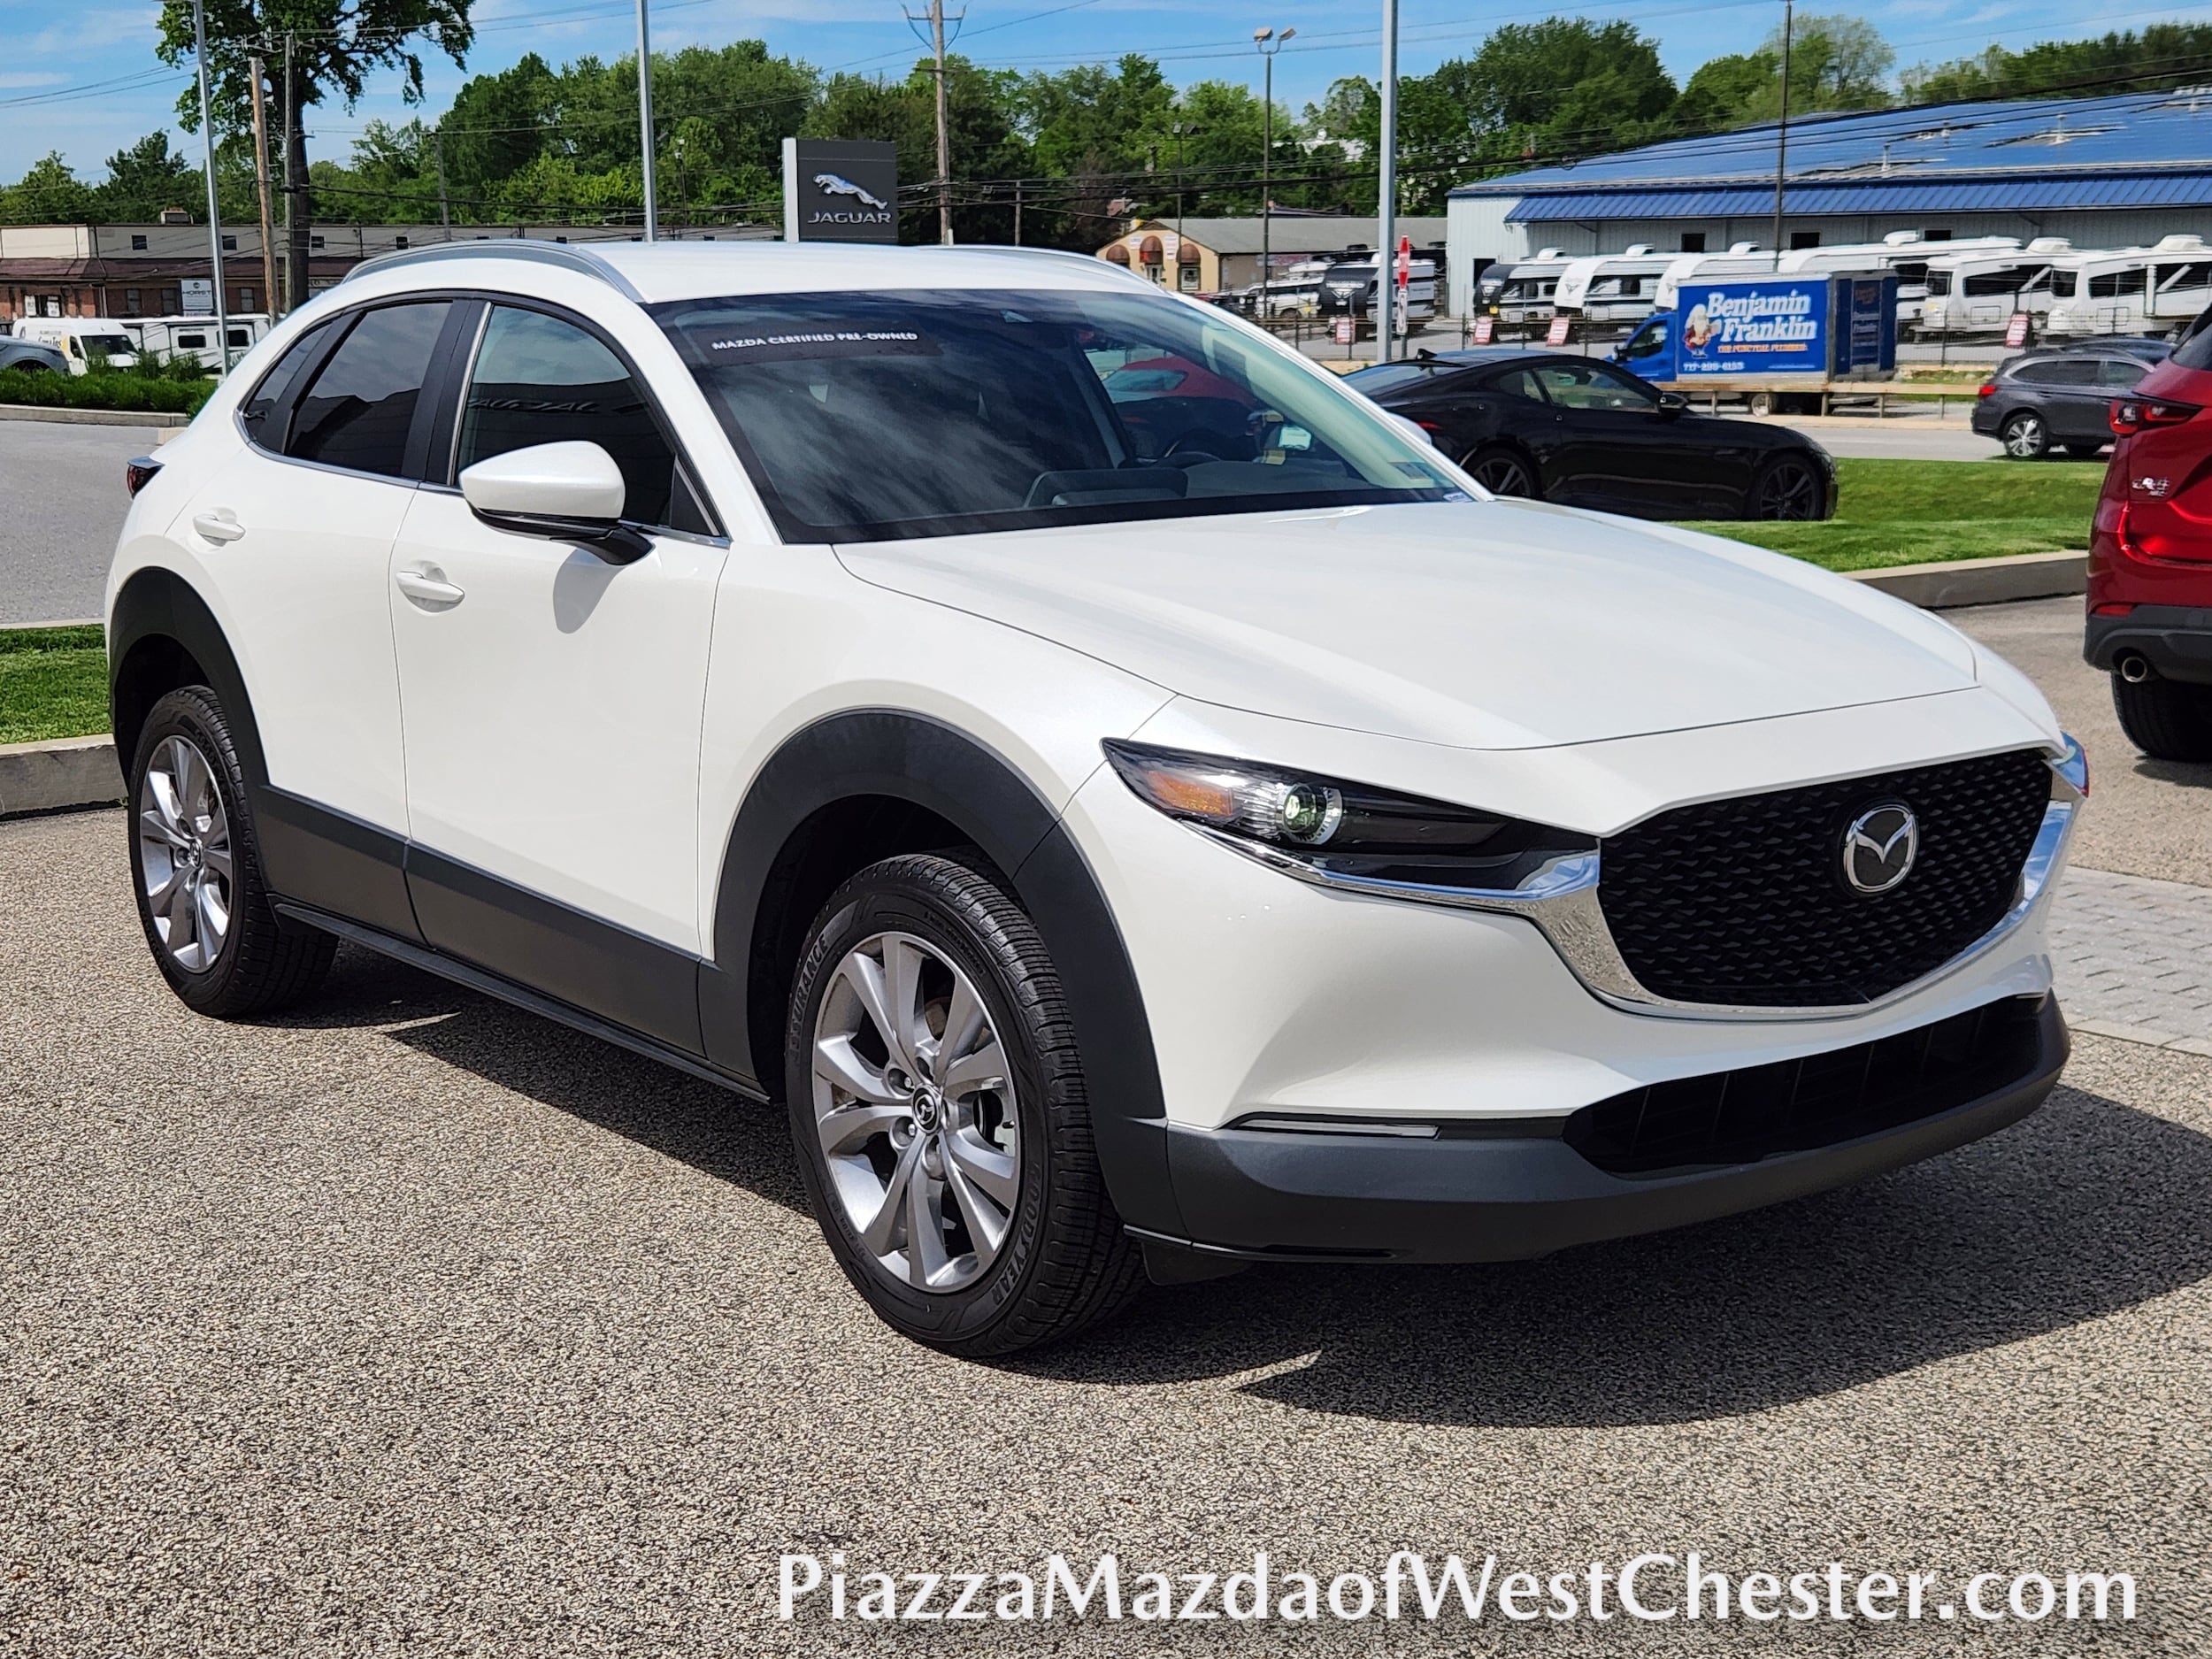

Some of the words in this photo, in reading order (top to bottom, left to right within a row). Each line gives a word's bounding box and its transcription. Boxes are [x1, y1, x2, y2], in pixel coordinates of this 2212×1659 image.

[807, 211, 892, 224] JAGUAR
[1706, 288, 1811, 322] Benjamin
[1721, 316, 1816, 342] Franklin
[711, 337, 766, 350] MAZDA
[768, 333, 835, 345] CERTIFIED
[837, 332, 918, 342] PRE-OWNED
